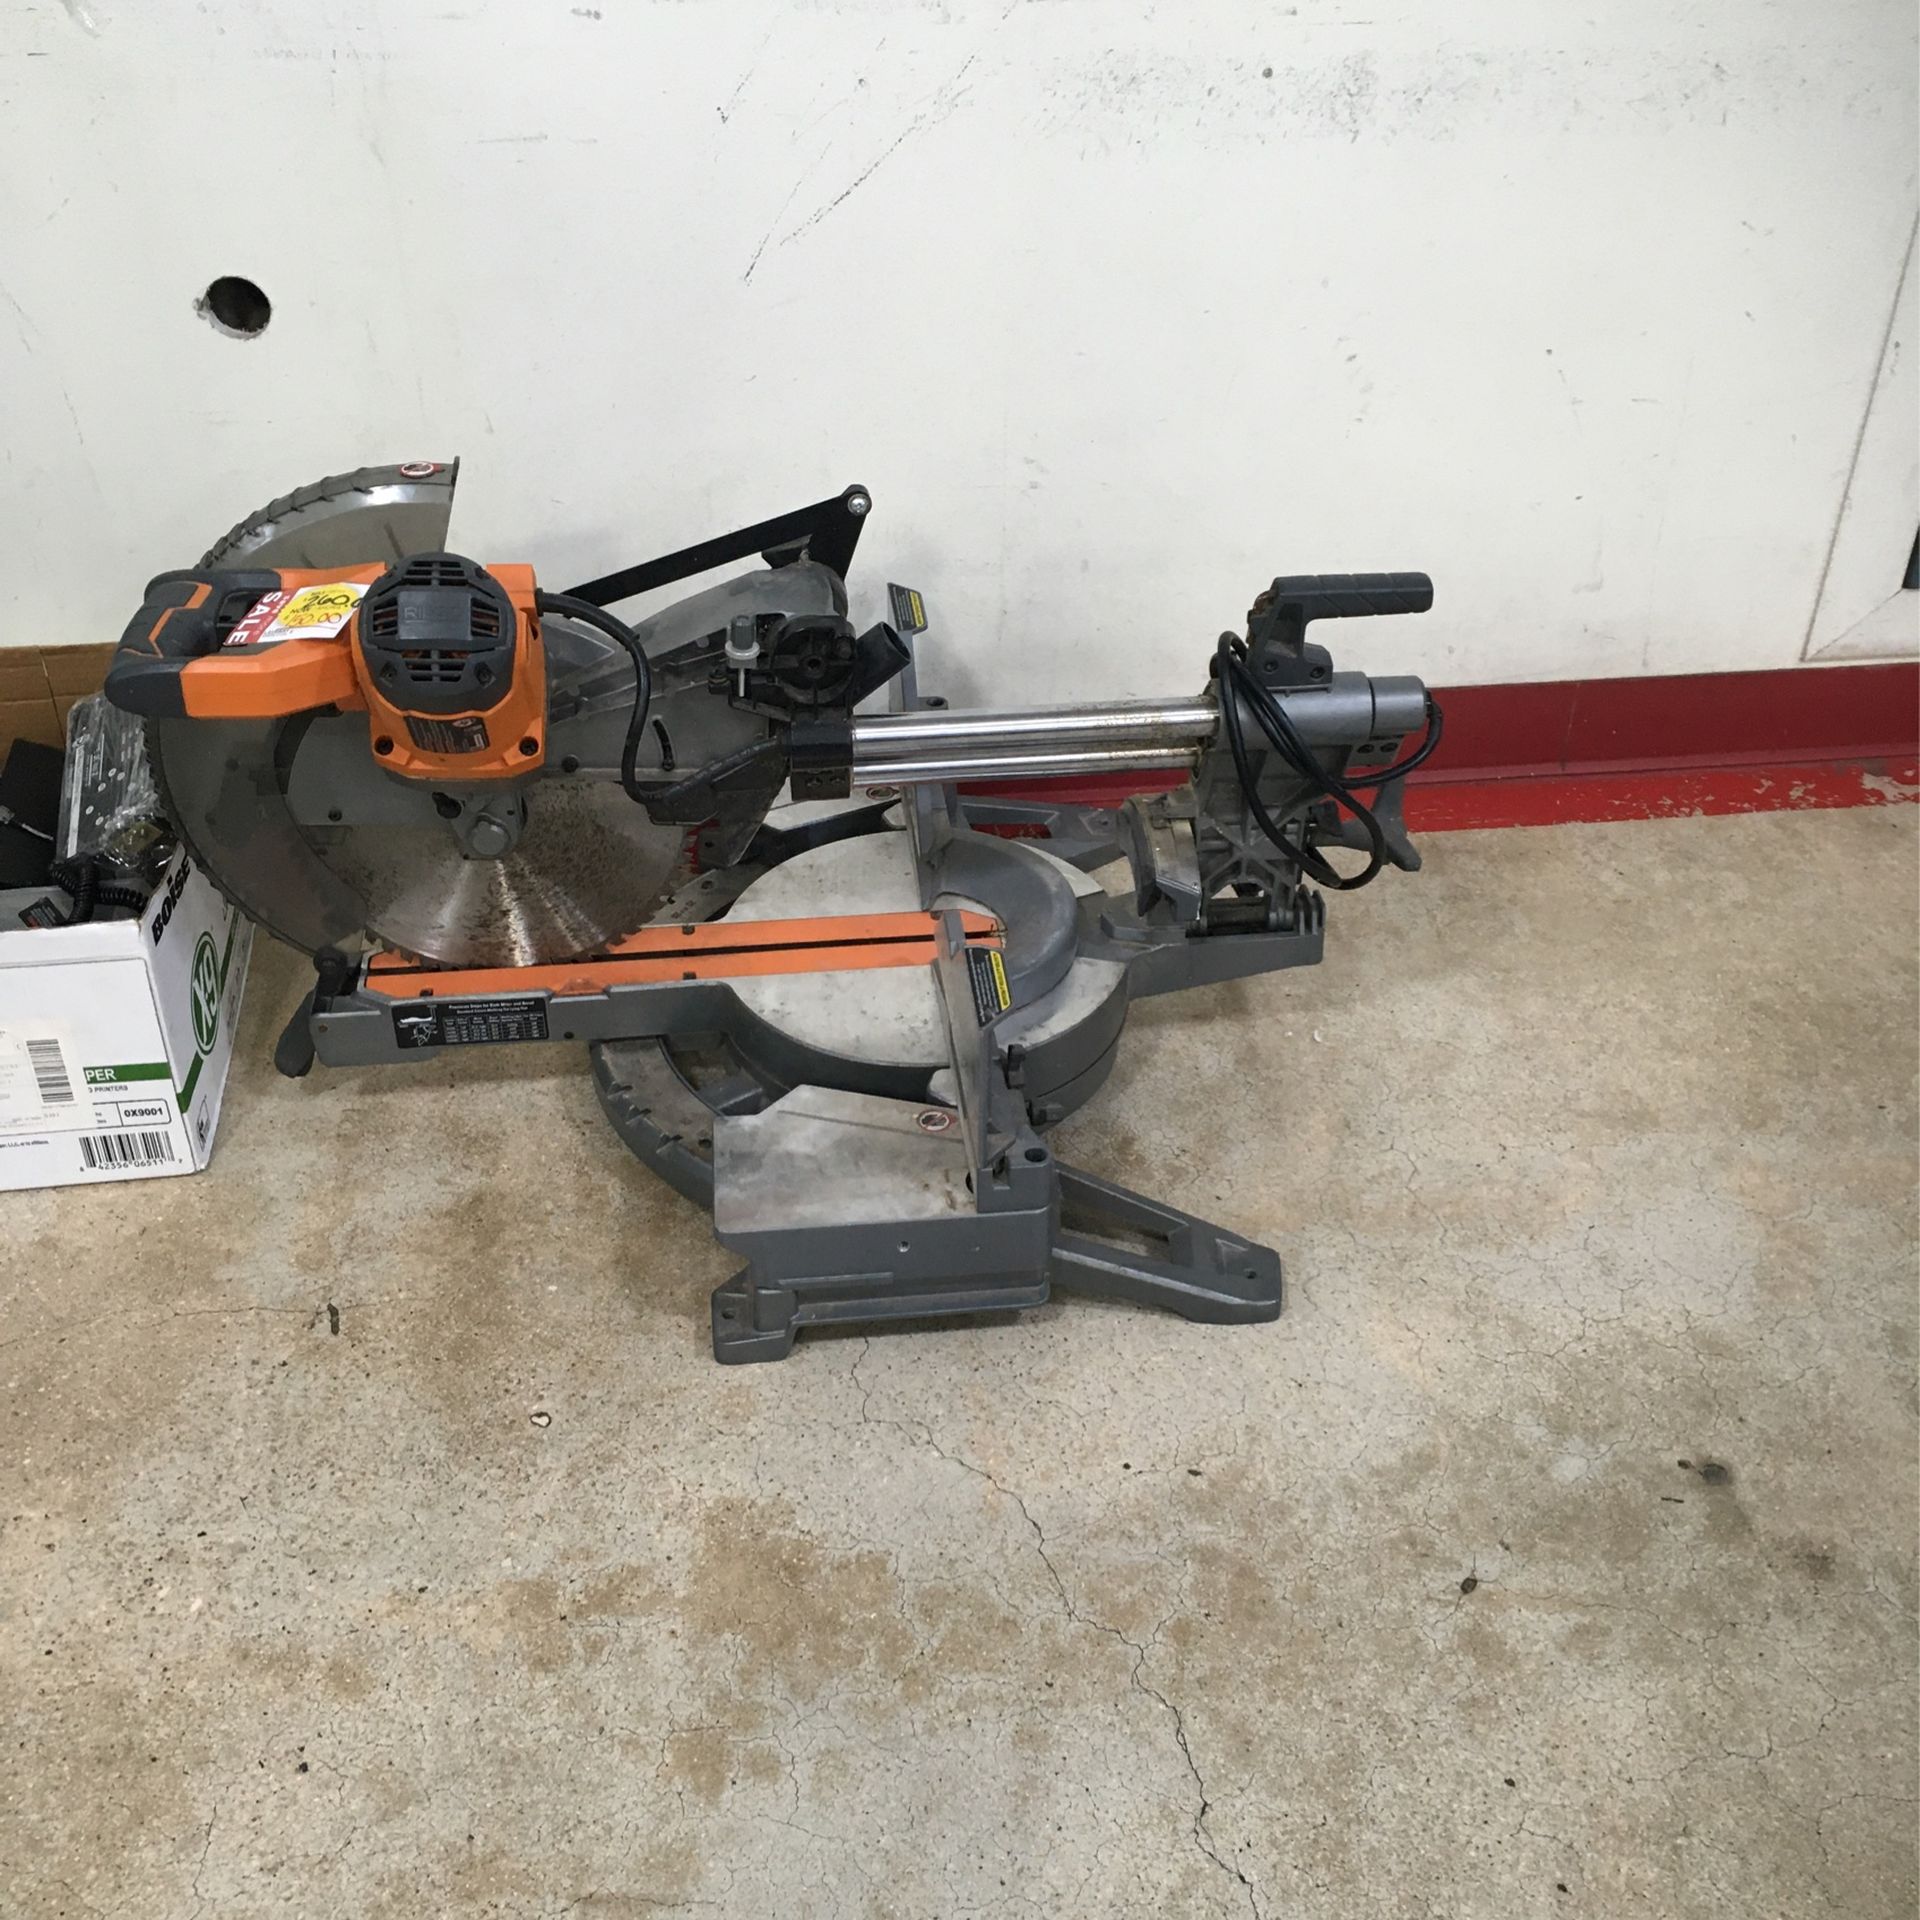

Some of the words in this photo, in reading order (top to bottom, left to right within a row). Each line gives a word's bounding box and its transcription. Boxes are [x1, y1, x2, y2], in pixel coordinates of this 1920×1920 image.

[229, 591, 283, 644] SALE
[85, 1068, 117, 1082] PER
[124, 1107, 163, 1118] 0X9001
